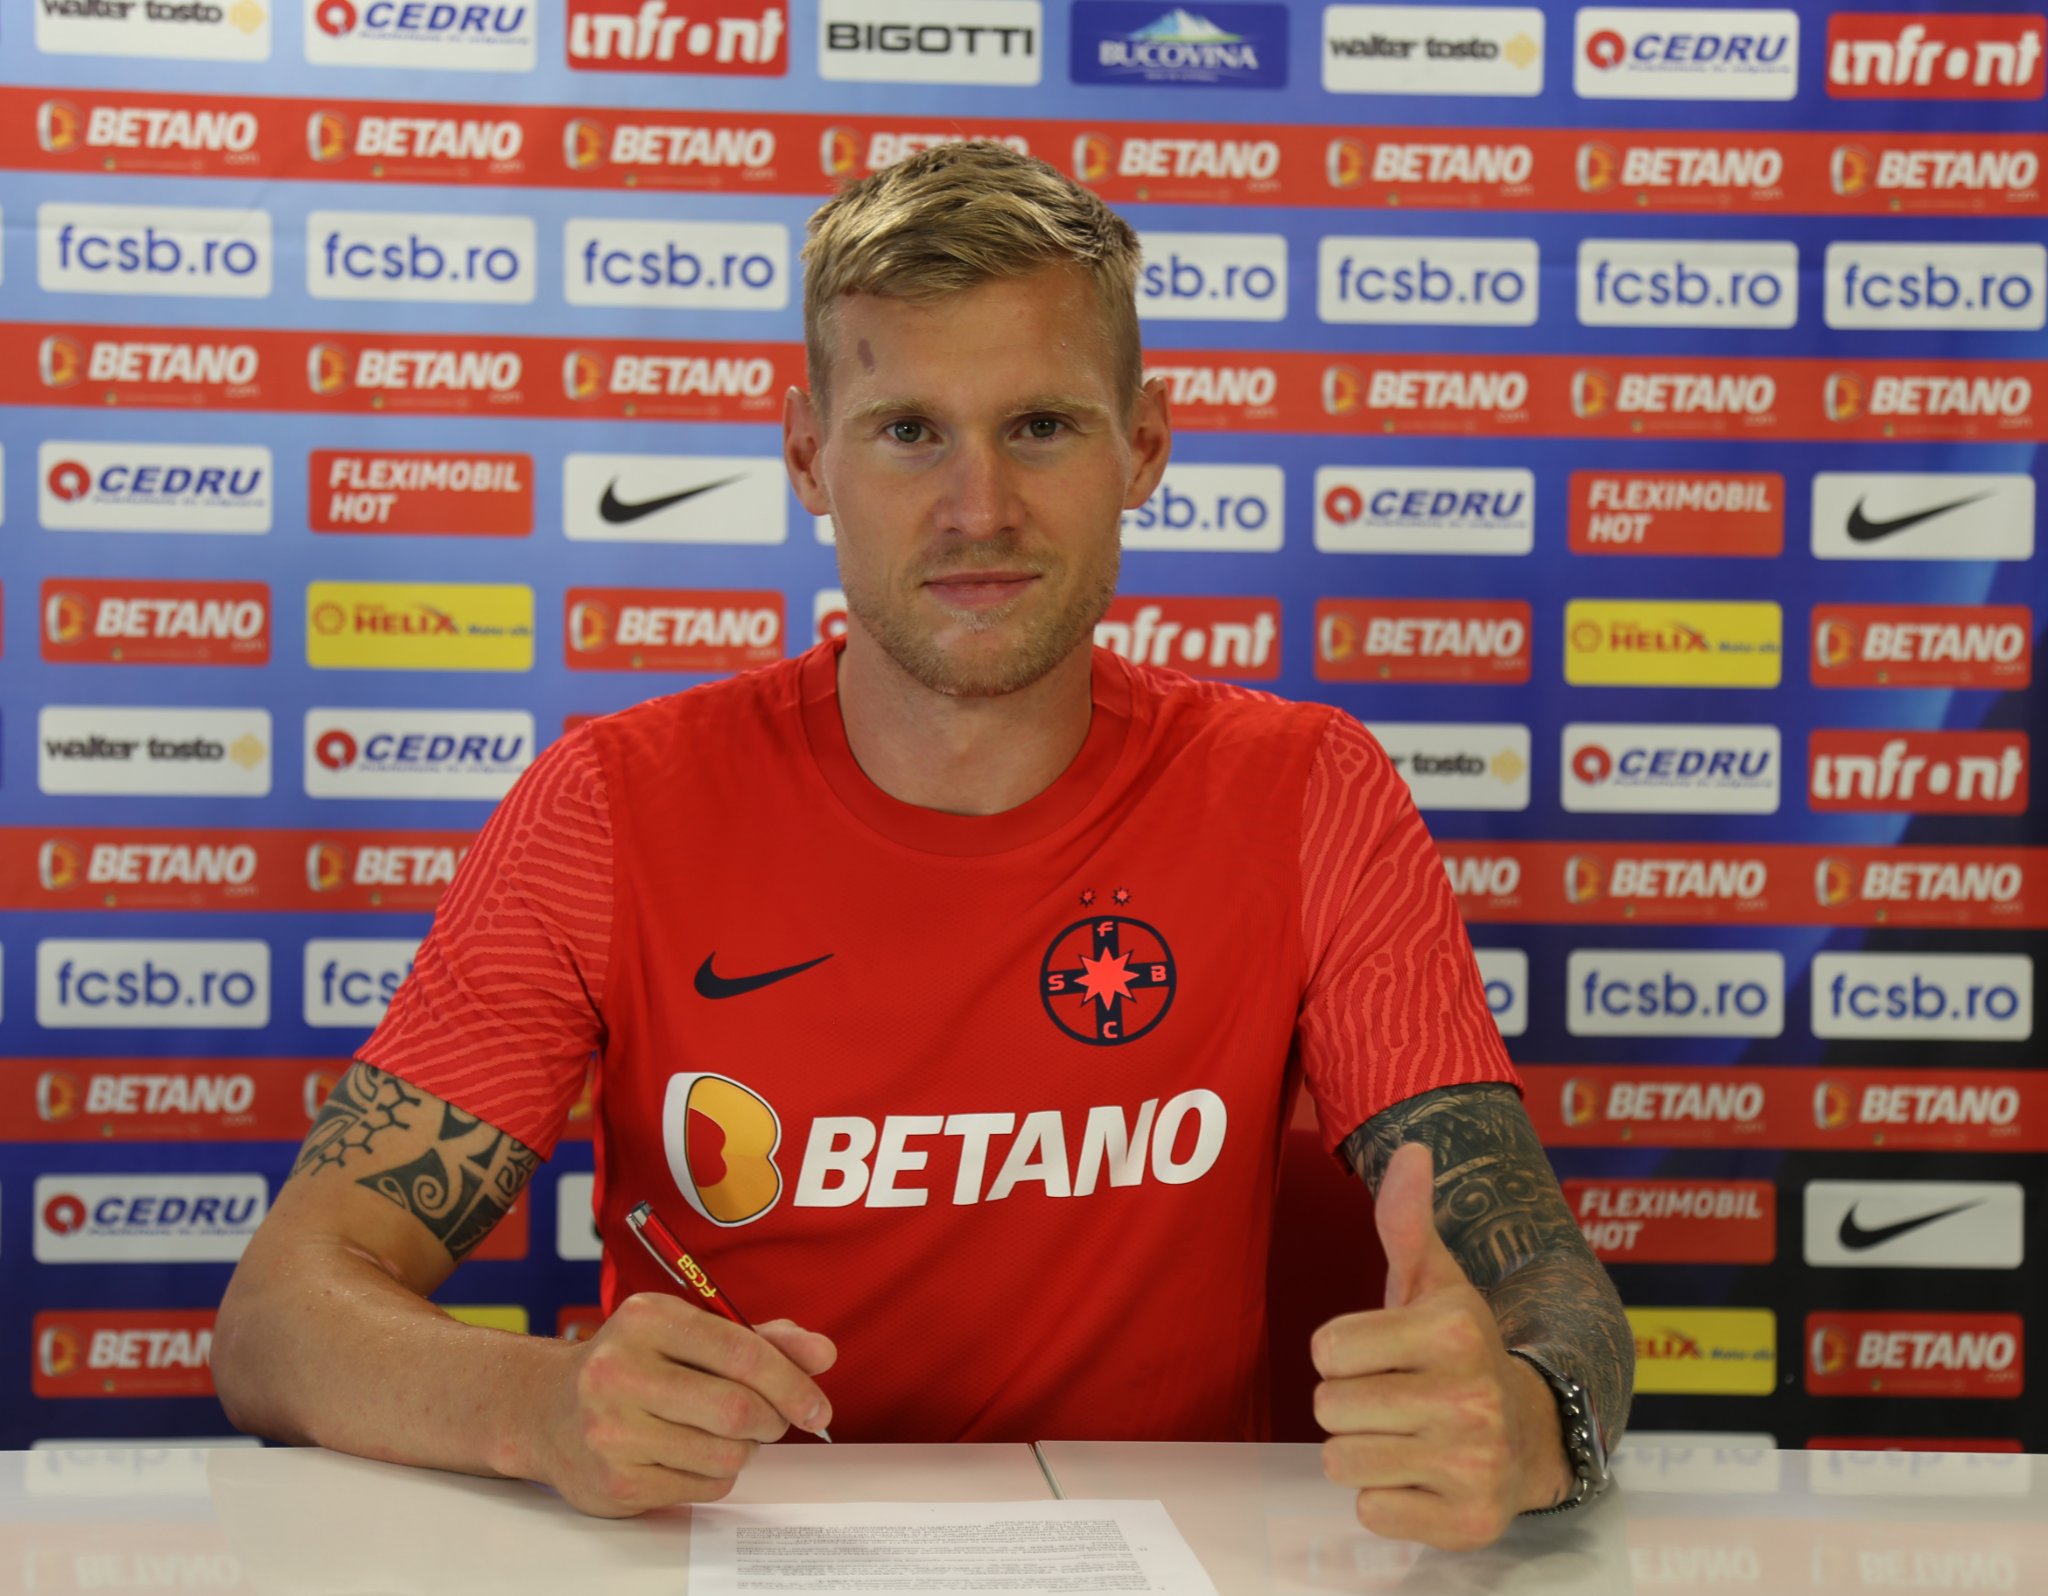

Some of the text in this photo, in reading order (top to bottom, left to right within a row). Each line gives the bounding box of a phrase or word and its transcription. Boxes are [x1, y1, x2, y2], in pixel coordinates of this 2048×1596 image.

[365, 1, 526, 33] CEDRU
[827, 23, 1033, 57] BIGOTTI
[1099, 40, 1259, 69] BUCOVINA
[1328, 31, 1499, 61] walter tosto
[1631, 34, 1789, 63] CEDRU
[87, 107, 257, 152] BETANO
[355, 117, 522, 161] BETANO
[611, 126, 774, 168] BETANO
[1118, 139, 1279, 180] BETANO
[1372, 144, 1532, 184] BETANO
[1622, 148, 1782, 187] BETANO
[1877, 151, 2038, 189] BETANO
[58, 223, 258, 276] fcsb.ro
[324, 231, 520, 283] fcsb.ro
[582, 238, 775, 290] fcsb.ro
[1142, 254, 1276, 300] sb.ro
[1337, 256, 1526, 305] fcsb.ro
[1595, 260, 1782, 308] fcsb.ro
[1844, 263, 2033, 310] fcsb.ro
[88, 342, 258, 385] BETANO
[355, 350, 521, 391] BETANO
[610, 356, 773, 397] BETANO
[1146, 366, 1276, 406] TANO
[1368, 371, 1527, 410] BETANO
[1616, 374, 1775, 413] BETANO
[1870, 377, 2031, 416] BETANO
[98, 466, 262, 496] CEDRU
[329, 458, 520, 492] FLEXIMOBIL
[329, 493, 397, 523] HOT
[1124, 486, 1268, 531] sb.ro
[1370, 490, 1524, 518] CEDRU
[1589, 480, 1771, 514] FLEXIMOBIL
[1588, 513, 1651, 543] HOT
[95, 599, 263, 639] BETANO
[354, 611, 458, 635] HELIX
[616, 608, 778, 648] BETANO
[1093, 606, 1276, 667] nfront
[1365, 619, 1524, 657] BETANO
[1610, 629, 1708, 652] HELIX
[1863, 624, 2024, 662] BETANO
[45, 735, 225, 762] walter tosto
[364, 734, 524, 763] CEDRU
[1411, 752, 1486, 776] tosto
[1618, 748, 1770, 778] CEDRU
[88, 845, 256, 884] BETANO
[355, 848, 467, 884] BETA
[1610, 860, 1766, 899] BETANO
[1862, 863, 2021, 901] BETANO
[57, 960, 257, 1008] fcsb.ro
[1048, 974, 1066, 991] S
[1151, 965, 1167, 982] B
[1583, 970, 1768, 1017] fcsb.ro
[1830, 973, 2020, 1021] fcsb.ro
[1103, 1021, 1118, 1039] C
[86, 1076, 254, 1113] BETANO
[1607, 1084, 1764, 1121] BETANO
[1860, 1086, 2019, 1125] BETANO
[794, 1089, 1227, 1208] BETANO
[93, 1197, 257, 1227] CEDRU
[1579, 1189, 1762, 1219] FLEXIMOBIL
[676, 1253, 717, 1298] FCSB
[1857, 1332, 2016, 1370] BETANO
